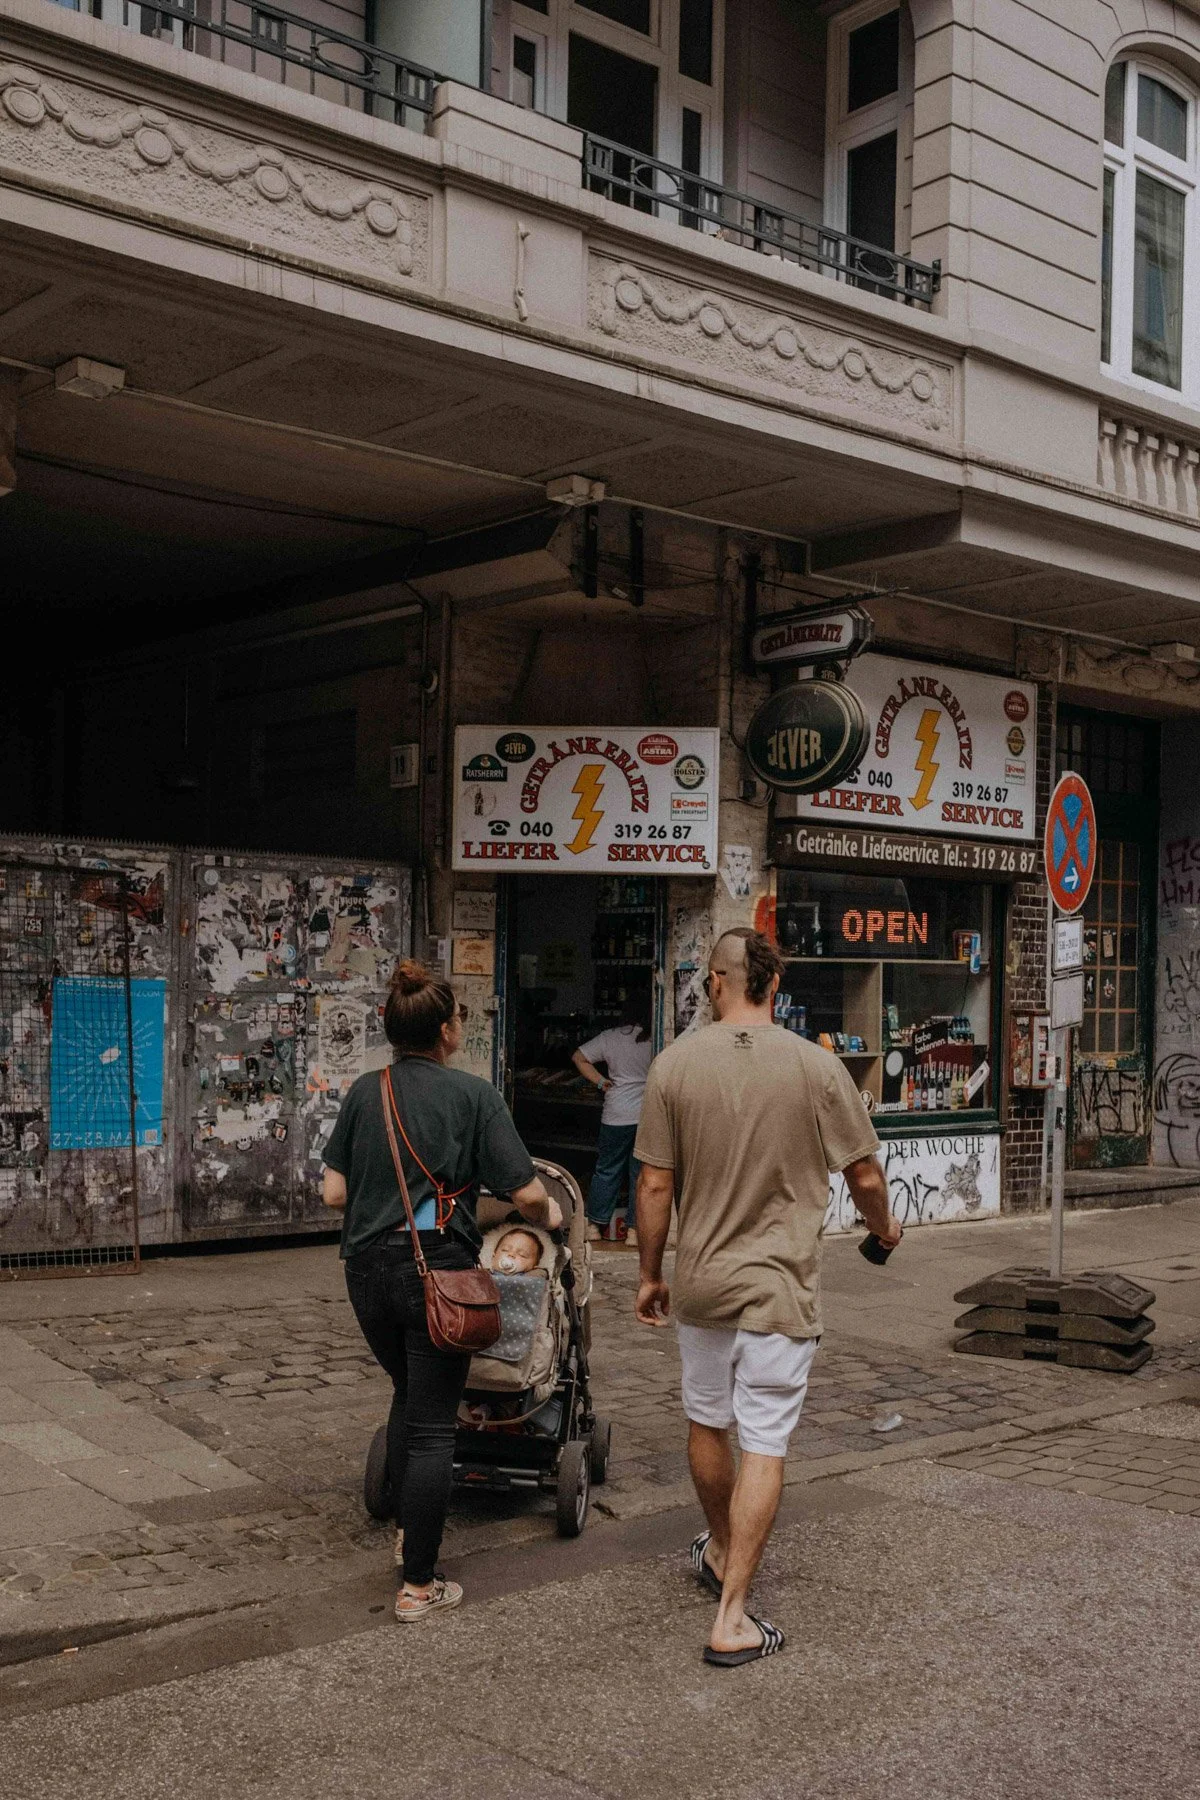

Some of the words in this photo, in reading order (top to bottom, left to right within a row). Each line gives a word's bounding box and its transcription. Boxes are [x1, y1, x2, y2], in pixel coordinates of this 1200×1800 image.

[761, 623, 843, 656] GETRÄNKEBLITZ
[874, 676, 973, 771] GETRÄNKEBLITZ
[504, 742, 527, 755] JEVER
[767, 727, 822, 771] JEVER
[466, 768, 504, 778] RATSHERRN
[520, 736, 649, 814] GETRÄNKEBLITZ
[673, 768, 706, 776] HOLSTEN
[868, 769, 893, 789] 040
[952, 782, 974, 799] 319
[976, 784, 992, 801] 26
[995, 787, 1009, 804] 87
[810, 787, 904, 817] LIEFER
[941, 801, 1024, 829] SERVICE
[520, 821, 553, 837] 040
[614, 824, 642, 839] 319
[648, 824, 668, 839] 26
[672, 825, 692, 840] 87
[462, 841, 560, 861] LIEFER
[607, 842, 707, 863] SERVICE
[796, 829, 858, 857] Getränke
[862, 834, 939, 866] Lieferservice
[942, 843, 968, 868] Tel.:
[972, 847, 995, 870] 319
[1000, 850, 1016, 873] 26
[1020, 852, 1037, 874] 87
[842, 909, 928, 944] OPEN
[887, 1140, 921, 1159] DER
[926, 1136, 985, 1156] WOCHE
